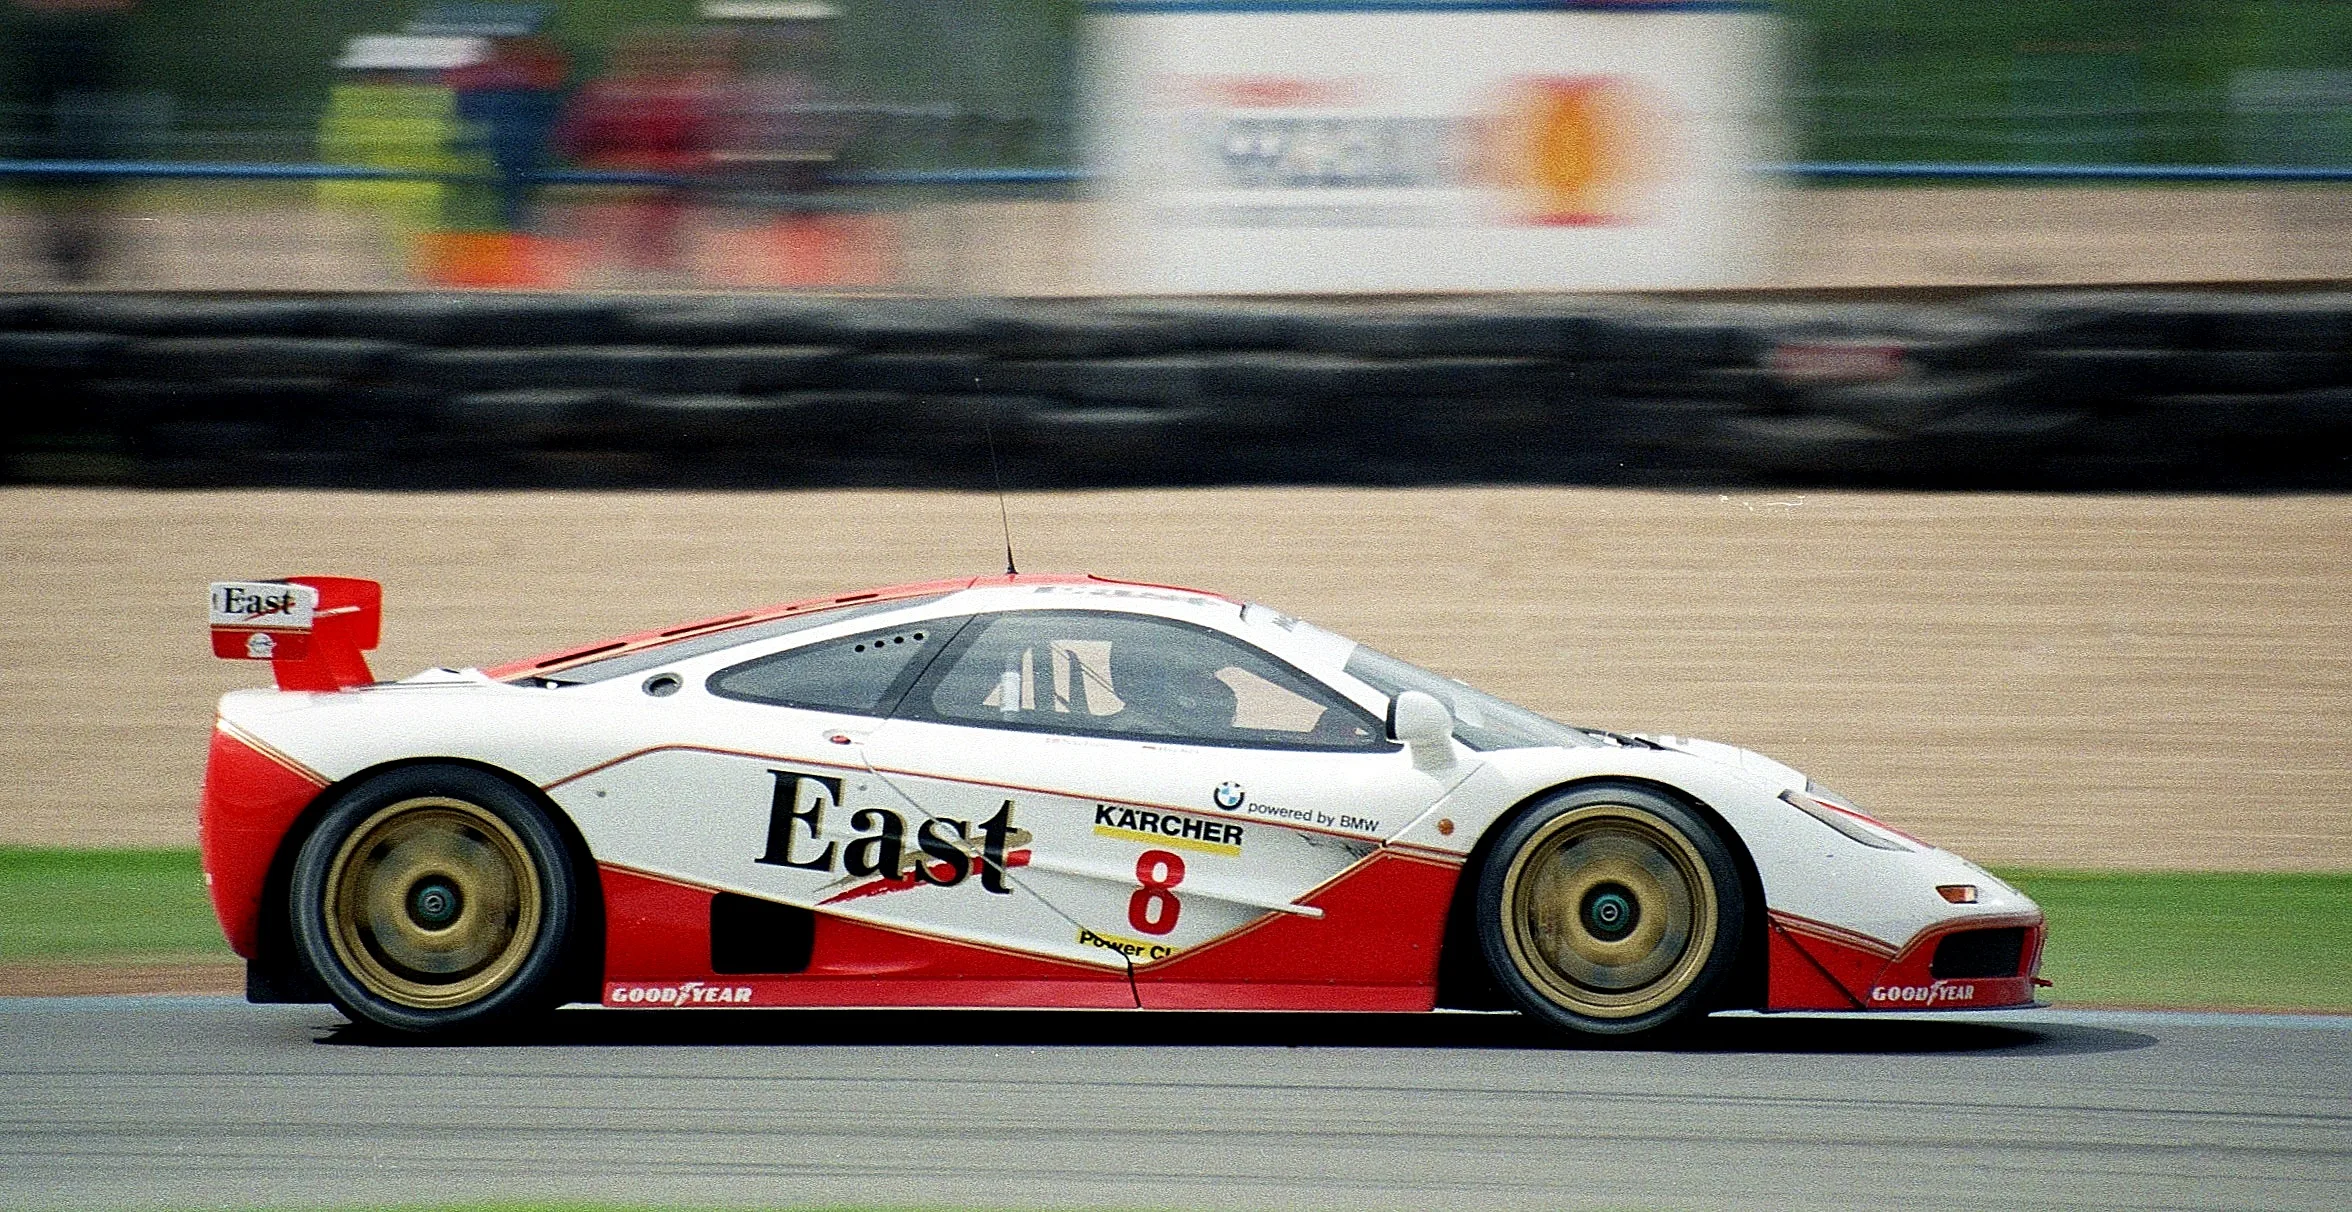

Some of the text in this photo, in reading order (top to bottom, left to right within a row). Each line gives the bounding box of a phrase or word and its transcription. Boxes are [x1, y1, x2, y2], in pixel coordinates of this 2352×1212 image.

[223, 588, 294, 615] East
[1095, 804, 1243, 846] KÄRCHER
[1249, 802, 1380, 832] powered by BMW
[755, 769, 1022, 895] East
[1128, 849, 1186, 936] 8
[1080, 931, 1144, 956] Power
[612, 983, 752, 1005] GOODYEAR
[1872, 982, 1975, 1004] GOODYEAR
